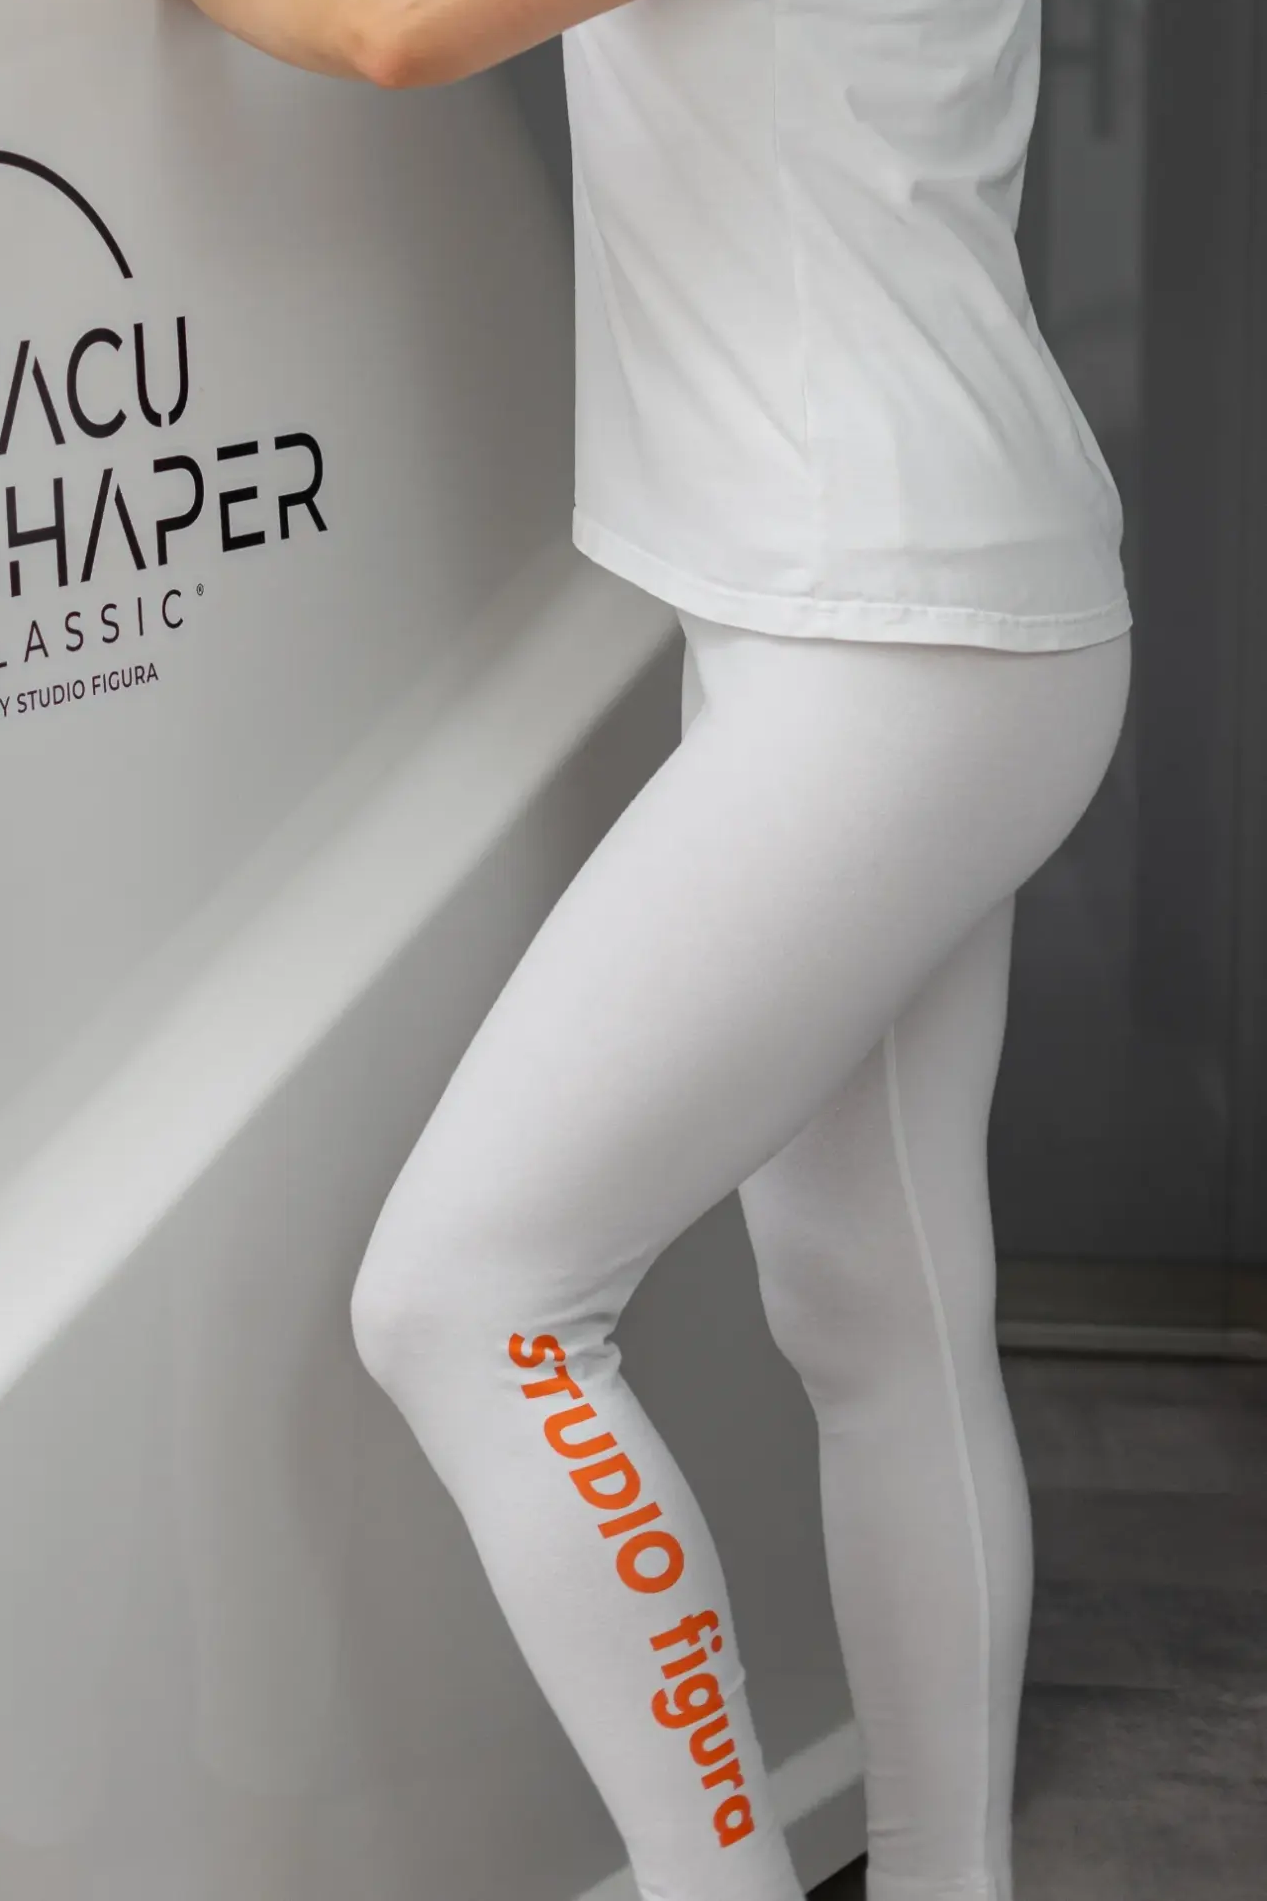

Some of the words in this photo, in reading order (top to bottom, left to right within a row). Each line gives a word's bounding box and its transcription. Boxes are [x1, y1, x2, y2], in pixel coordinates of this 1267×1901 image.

[16, 679, 86, 714] STUDIO
[91, 662, 159, 696] FIGURA
[507, 1333, 685, 1594] STUDIO
[650, 1610, 756, 1848] figura
